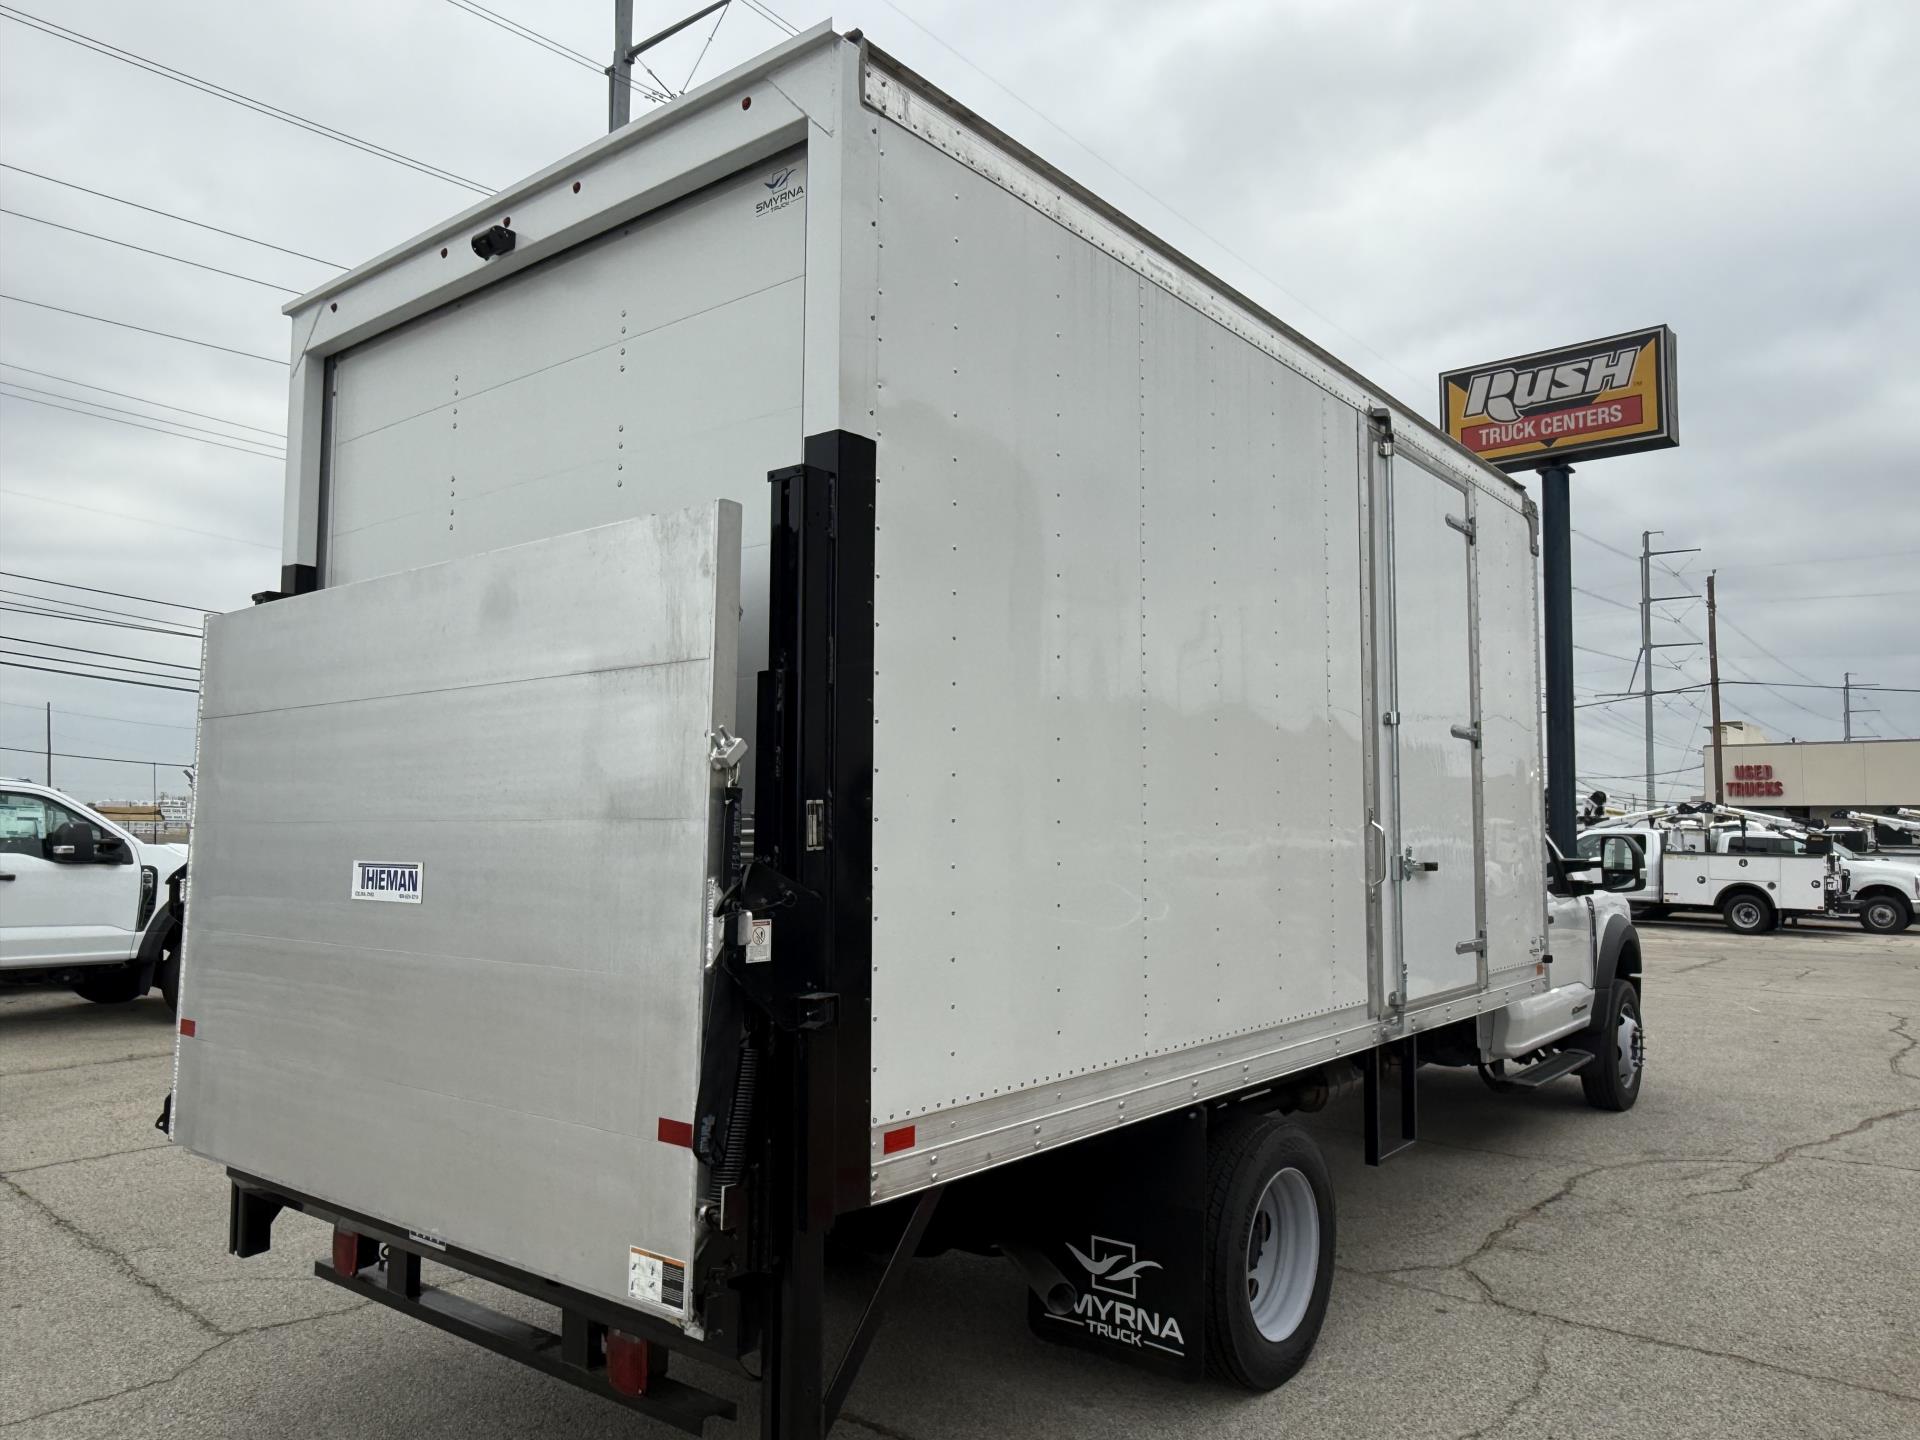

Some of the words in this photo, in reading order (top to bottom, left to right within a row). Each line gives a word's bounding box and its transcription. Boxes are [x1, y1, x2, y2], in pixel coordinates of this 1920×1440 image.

[756, 186, 804, 213] SMYRNA
[1463, 346, 1640, 423] RUSH
[1479, 423, 1536, 446] TRUCK
[1540, 404, 1623, 435] CENTERS
[1734, 764, 1773, 780] USED
[1726, 781, 1784, 798] TRUCKS
[358, 862, 418, 892] THIEMAN
[1073, 1293, 1185, 1345] MYRNA
[1085, 1319, 1142, 1348] TRUCK
